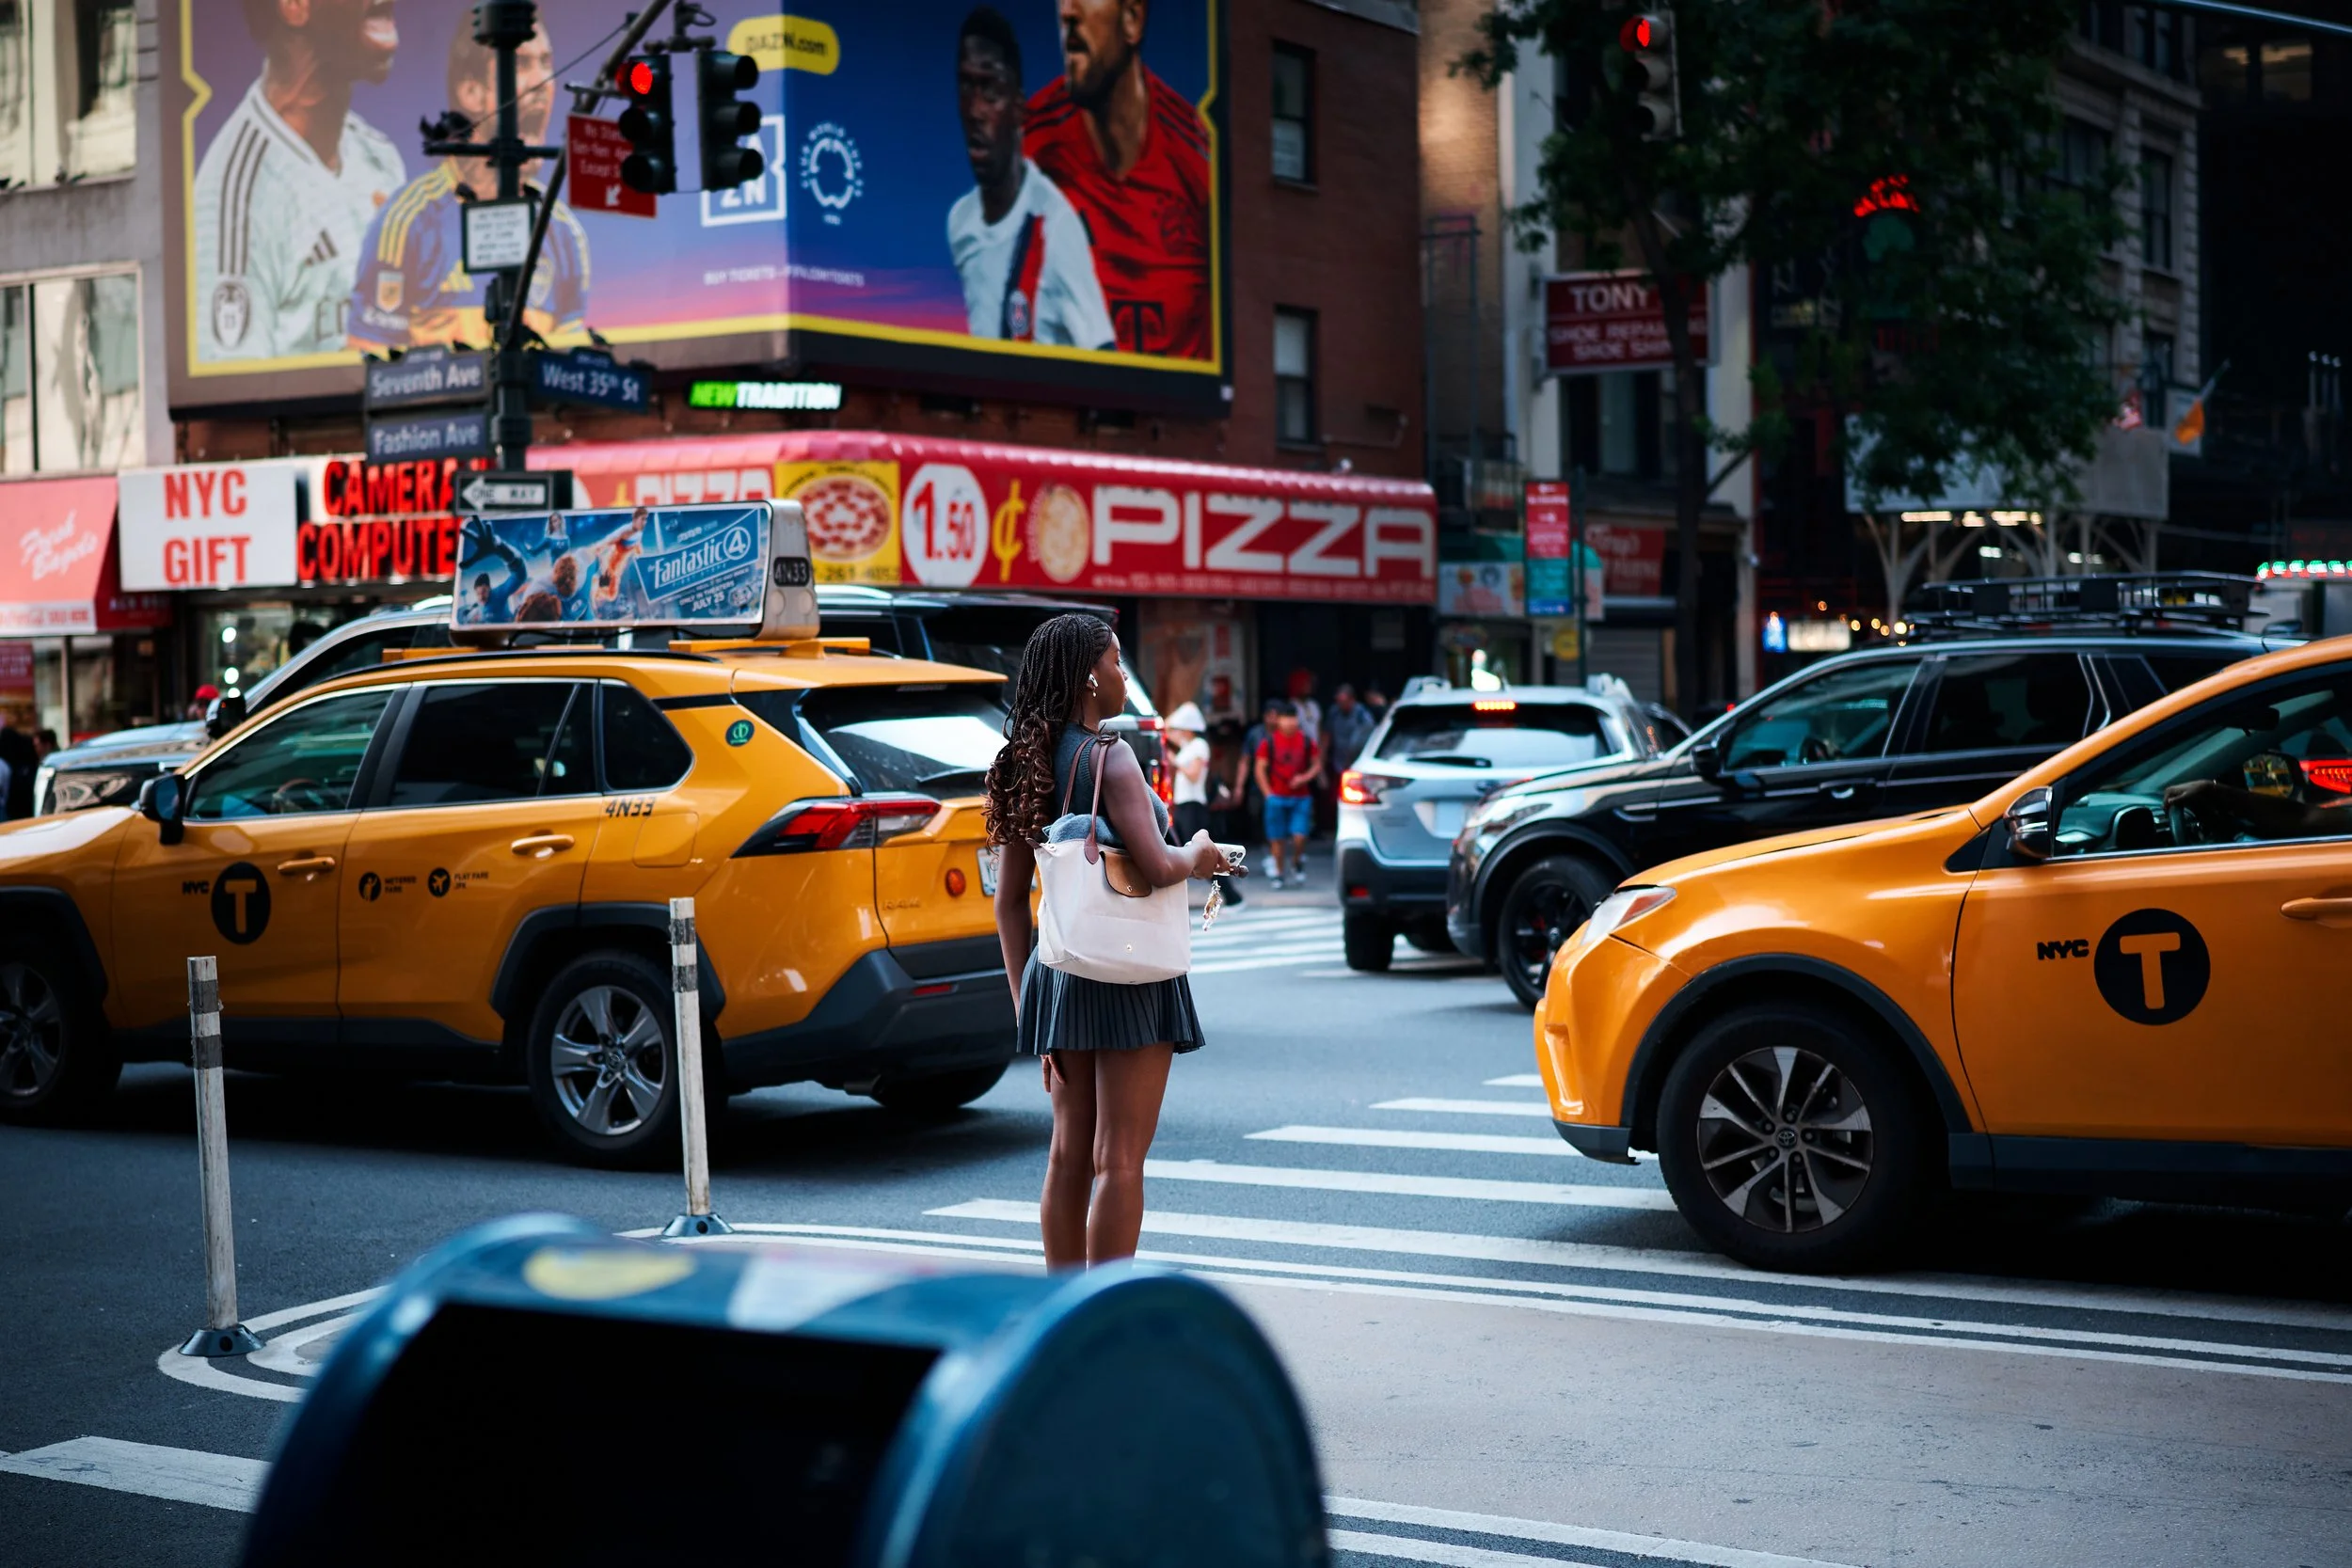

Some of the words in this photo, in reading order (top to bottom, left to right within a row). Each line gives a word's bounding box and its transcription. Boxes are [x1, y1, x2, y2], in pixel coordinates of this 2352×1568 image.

[1568, 282, 1649, 313] TONY
[371, 364, 441, 398] Seventh
[446, 364, 482, 388] Ave
[543, 364, 584, 393] West
[621, 377, 640, 403] St
[373, 427, 442, 455] Fashion
[445, 422, 481, 448] Ave
[164, 468, 248, 520] NYC
[509, 487, 537, 499] WAY
[912, 480, 977, 561] 1.50
[1091, 483, 1435, 579] PIZZA
[162, 534, 252, 589] GIFT
[296, 517, 462, 582] COMPUTE
[654, 539, 723, 590] Fantastic
[727, 531, 747, 555] 4
[774, 562, 807, 581] 4N33
[678, 594, 696, 607] ONLY
[691, 595, 712, 612] JULY
[713, 590, 725, 603] 25
[606, 796, 657, 818] 4N33
[385, 876, 417, 885] METERED
[453, 873, 471, 881] FLAT
[471, 871, 489, 880] FARE
[183, 880, 209, 895] NYC
[224, 879, 258, 935] T
[2037, 939, 2090, 960] NYC
[2119, 931, 2181, 1010] T
